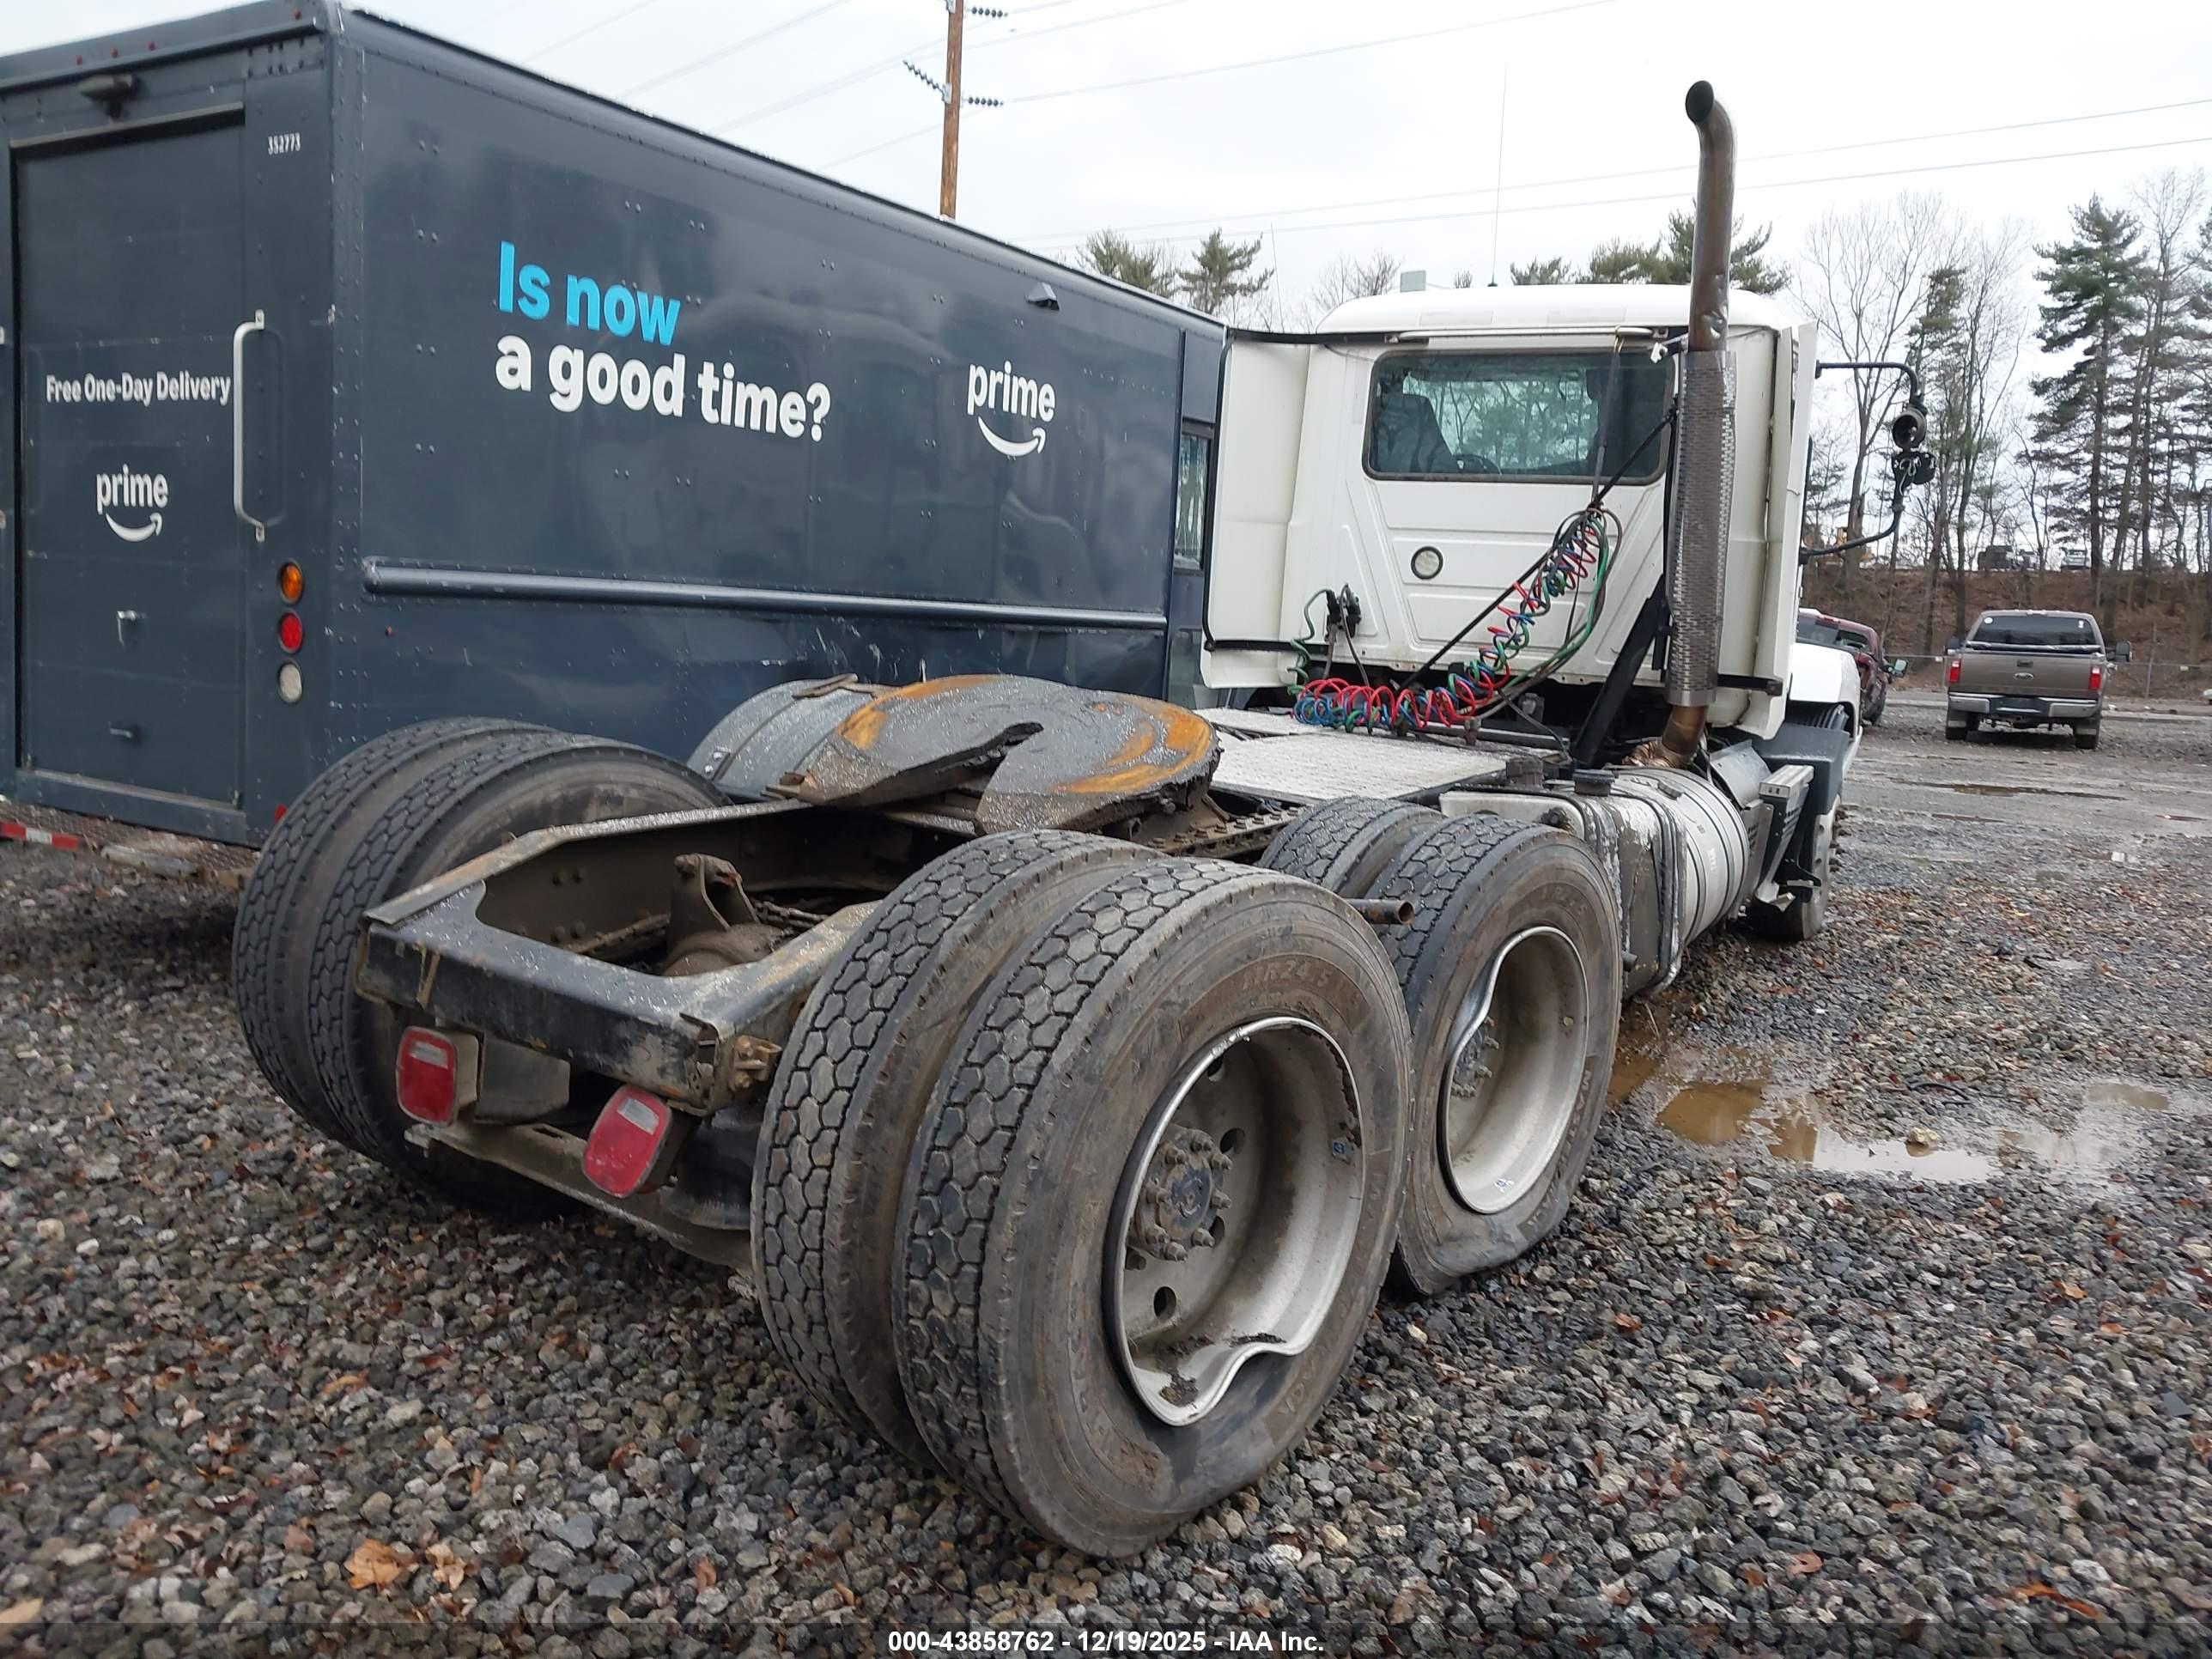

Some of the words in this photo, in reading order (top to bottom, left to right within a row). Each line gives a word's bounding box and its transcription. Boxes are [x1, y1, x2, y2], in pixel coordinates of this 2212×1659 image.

[267, 132, 302, 155] 352773
[498, 241, 550, 320] Is
[566, 274, 681, 346] now
[46, 373, 82, 403] Free
[83, 370, 154, 407] One-Day
[156, 370, 232, 406] Delivery
[495, 335, 532, 392] a
[548, 344, 686, 417] good
[697, 361, 831, 442] time?
[967, 360, 1056, 422] prime
[96, 463, 169, 516] prime
